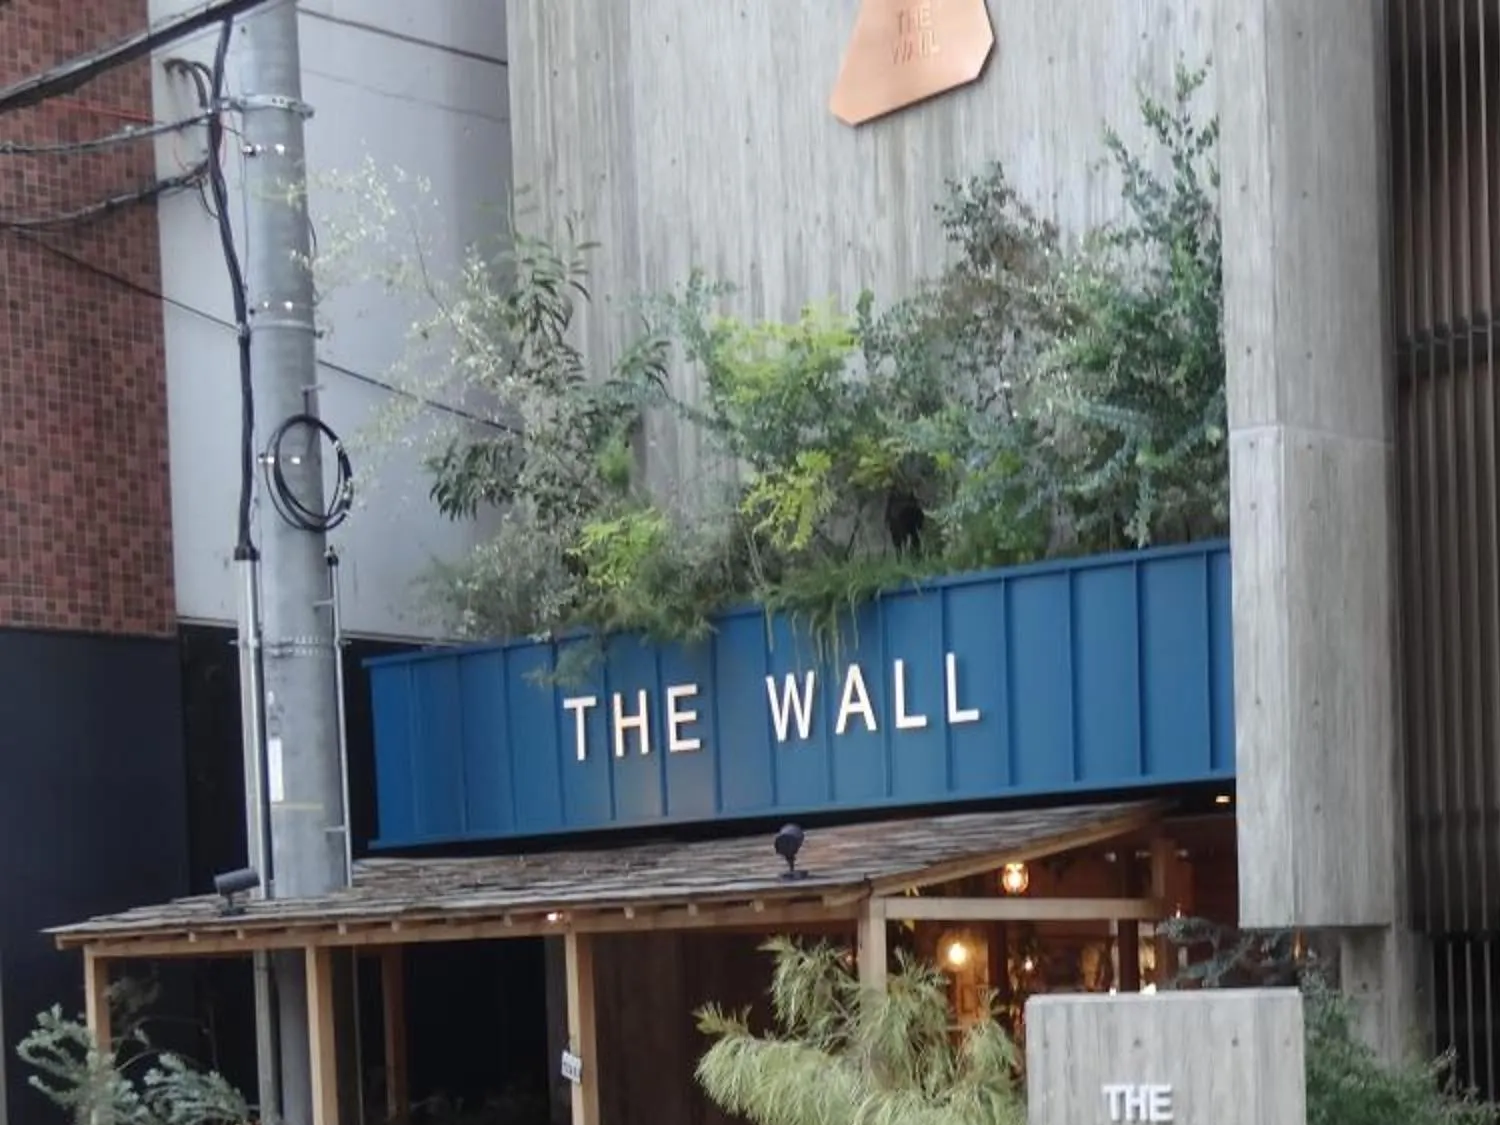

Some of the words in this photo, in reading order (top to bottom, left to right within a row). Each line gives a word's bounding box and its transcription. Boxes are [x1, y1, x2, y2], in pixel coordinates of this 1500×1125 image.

[563, 683, 701, 761] THE
[765, 652, 981, 742] WALL
[1102, 1084, 1174, 1122] THE
